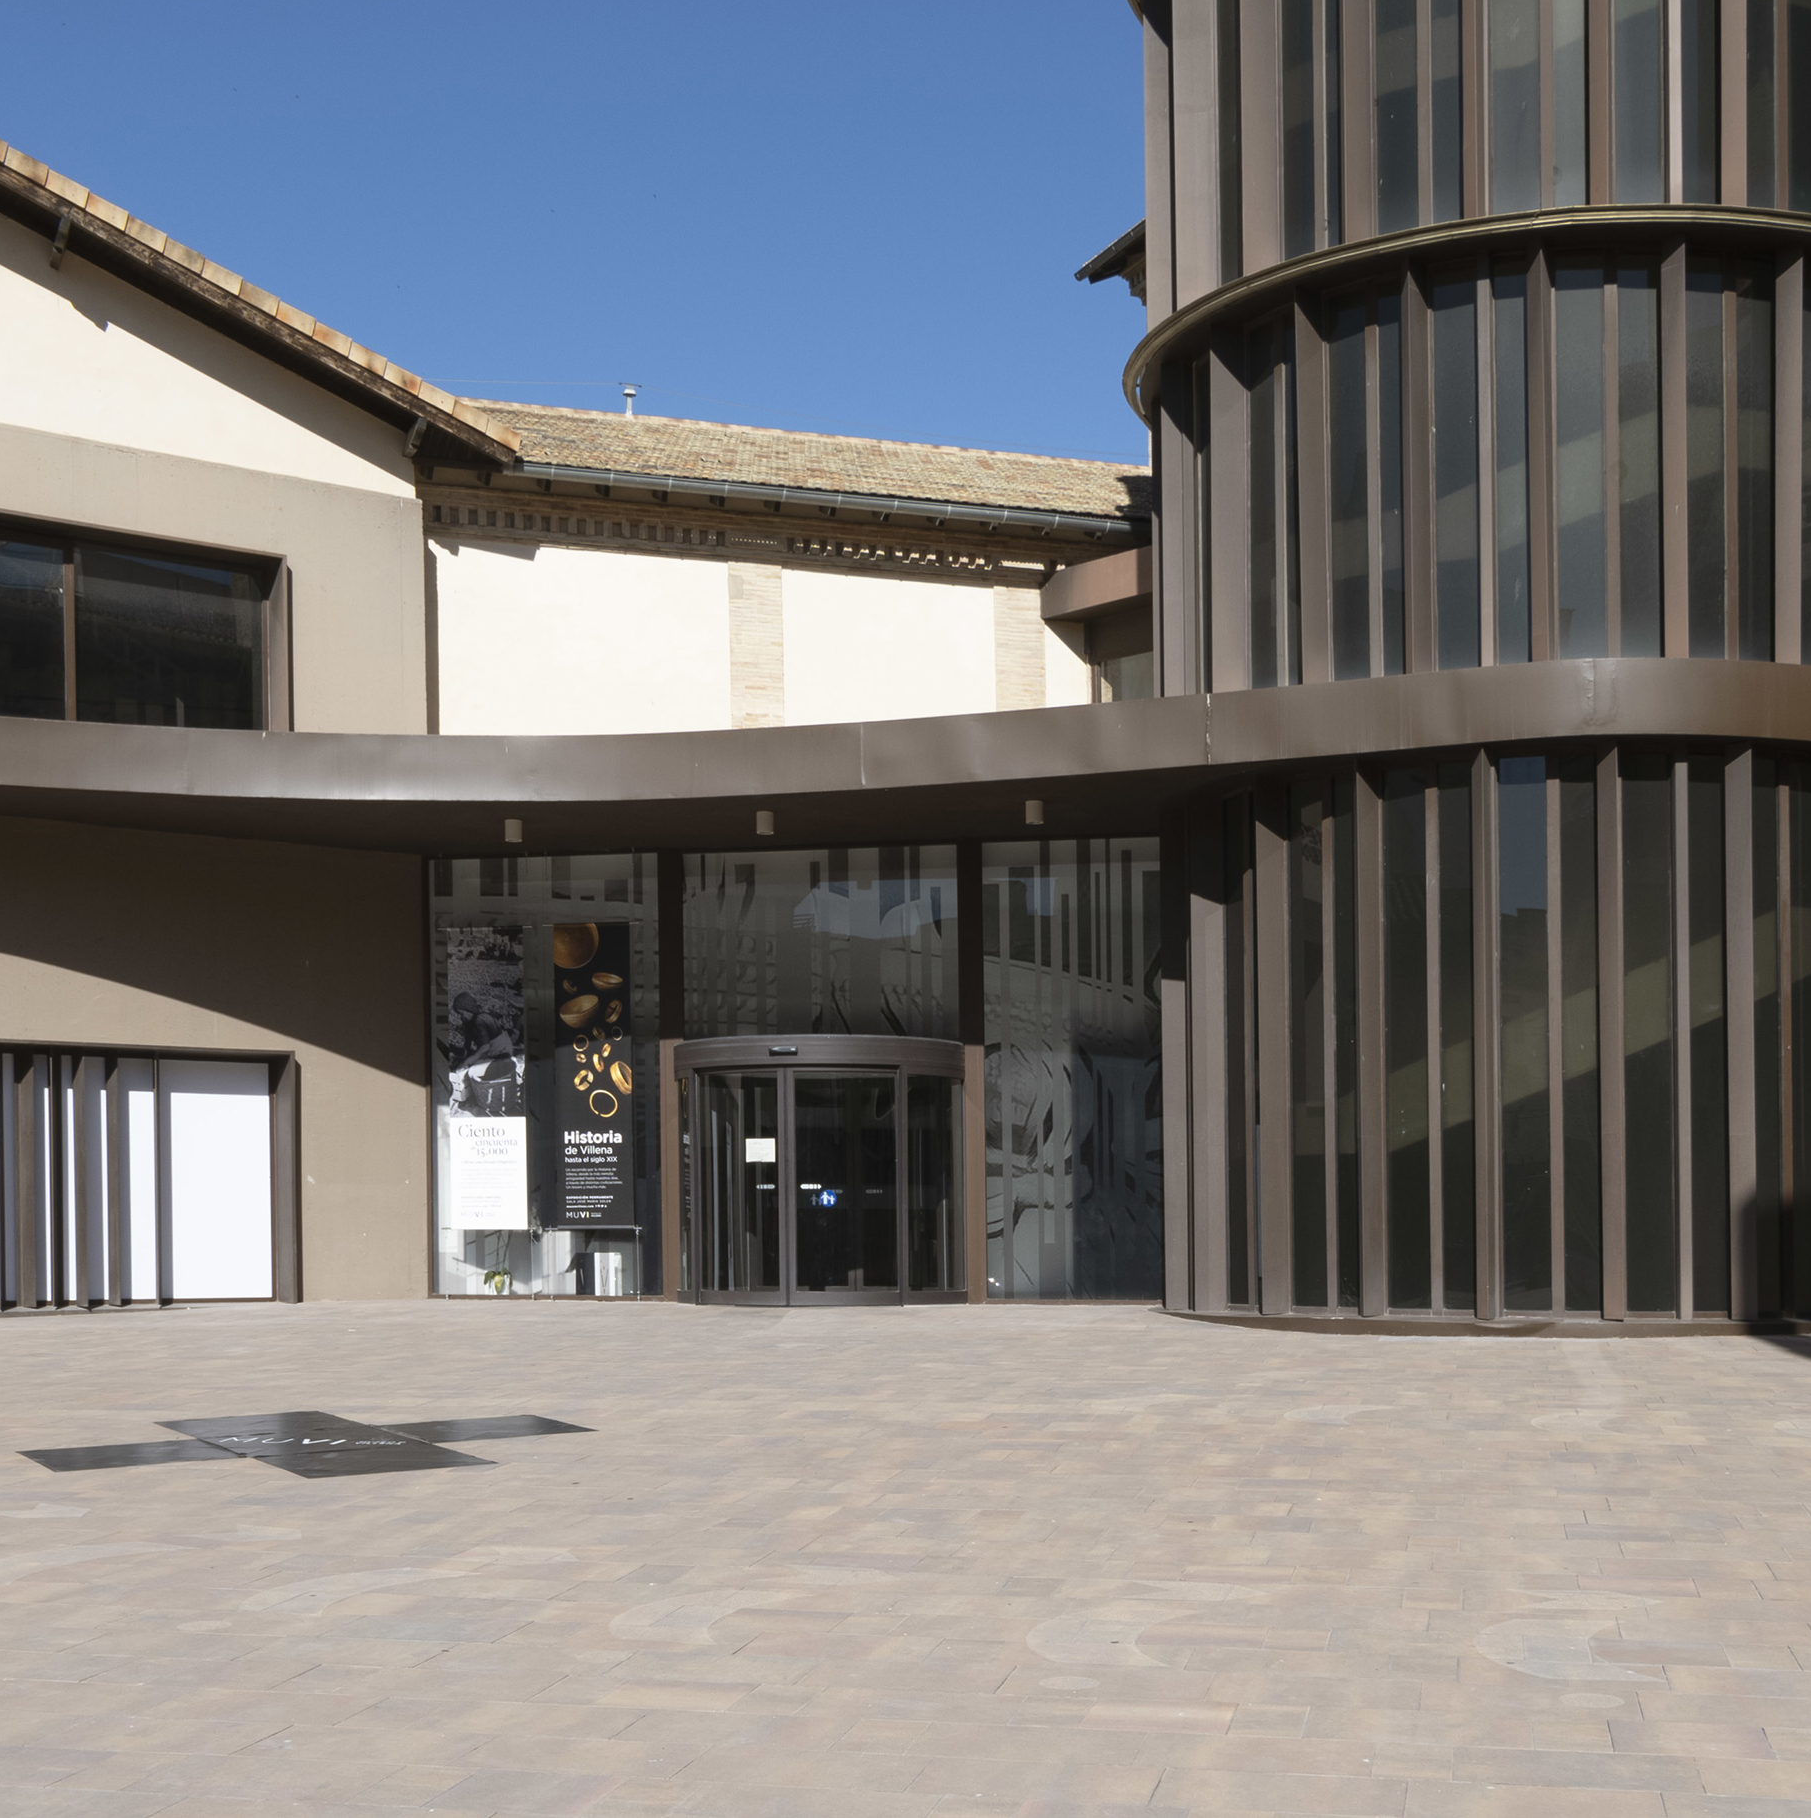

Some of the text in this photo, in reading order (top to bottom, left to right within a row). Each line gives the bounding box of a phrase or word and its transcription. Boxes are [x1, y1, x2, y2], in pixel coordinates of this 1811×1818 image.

[458, 1124, 506, 1138] Ciento
[564, 1129, 623, 1144] Historia
[475, 1138, 518, 1147] cincuenta
[476, 1147, 509, 1158] 15.000
[564, 1145, 613, 1155] de Villena
[590, 1156, 606, 1164] siglo
[566, 1211, 590, 1219] MUVI
[219, 1436, 347, 1445] MUVI
